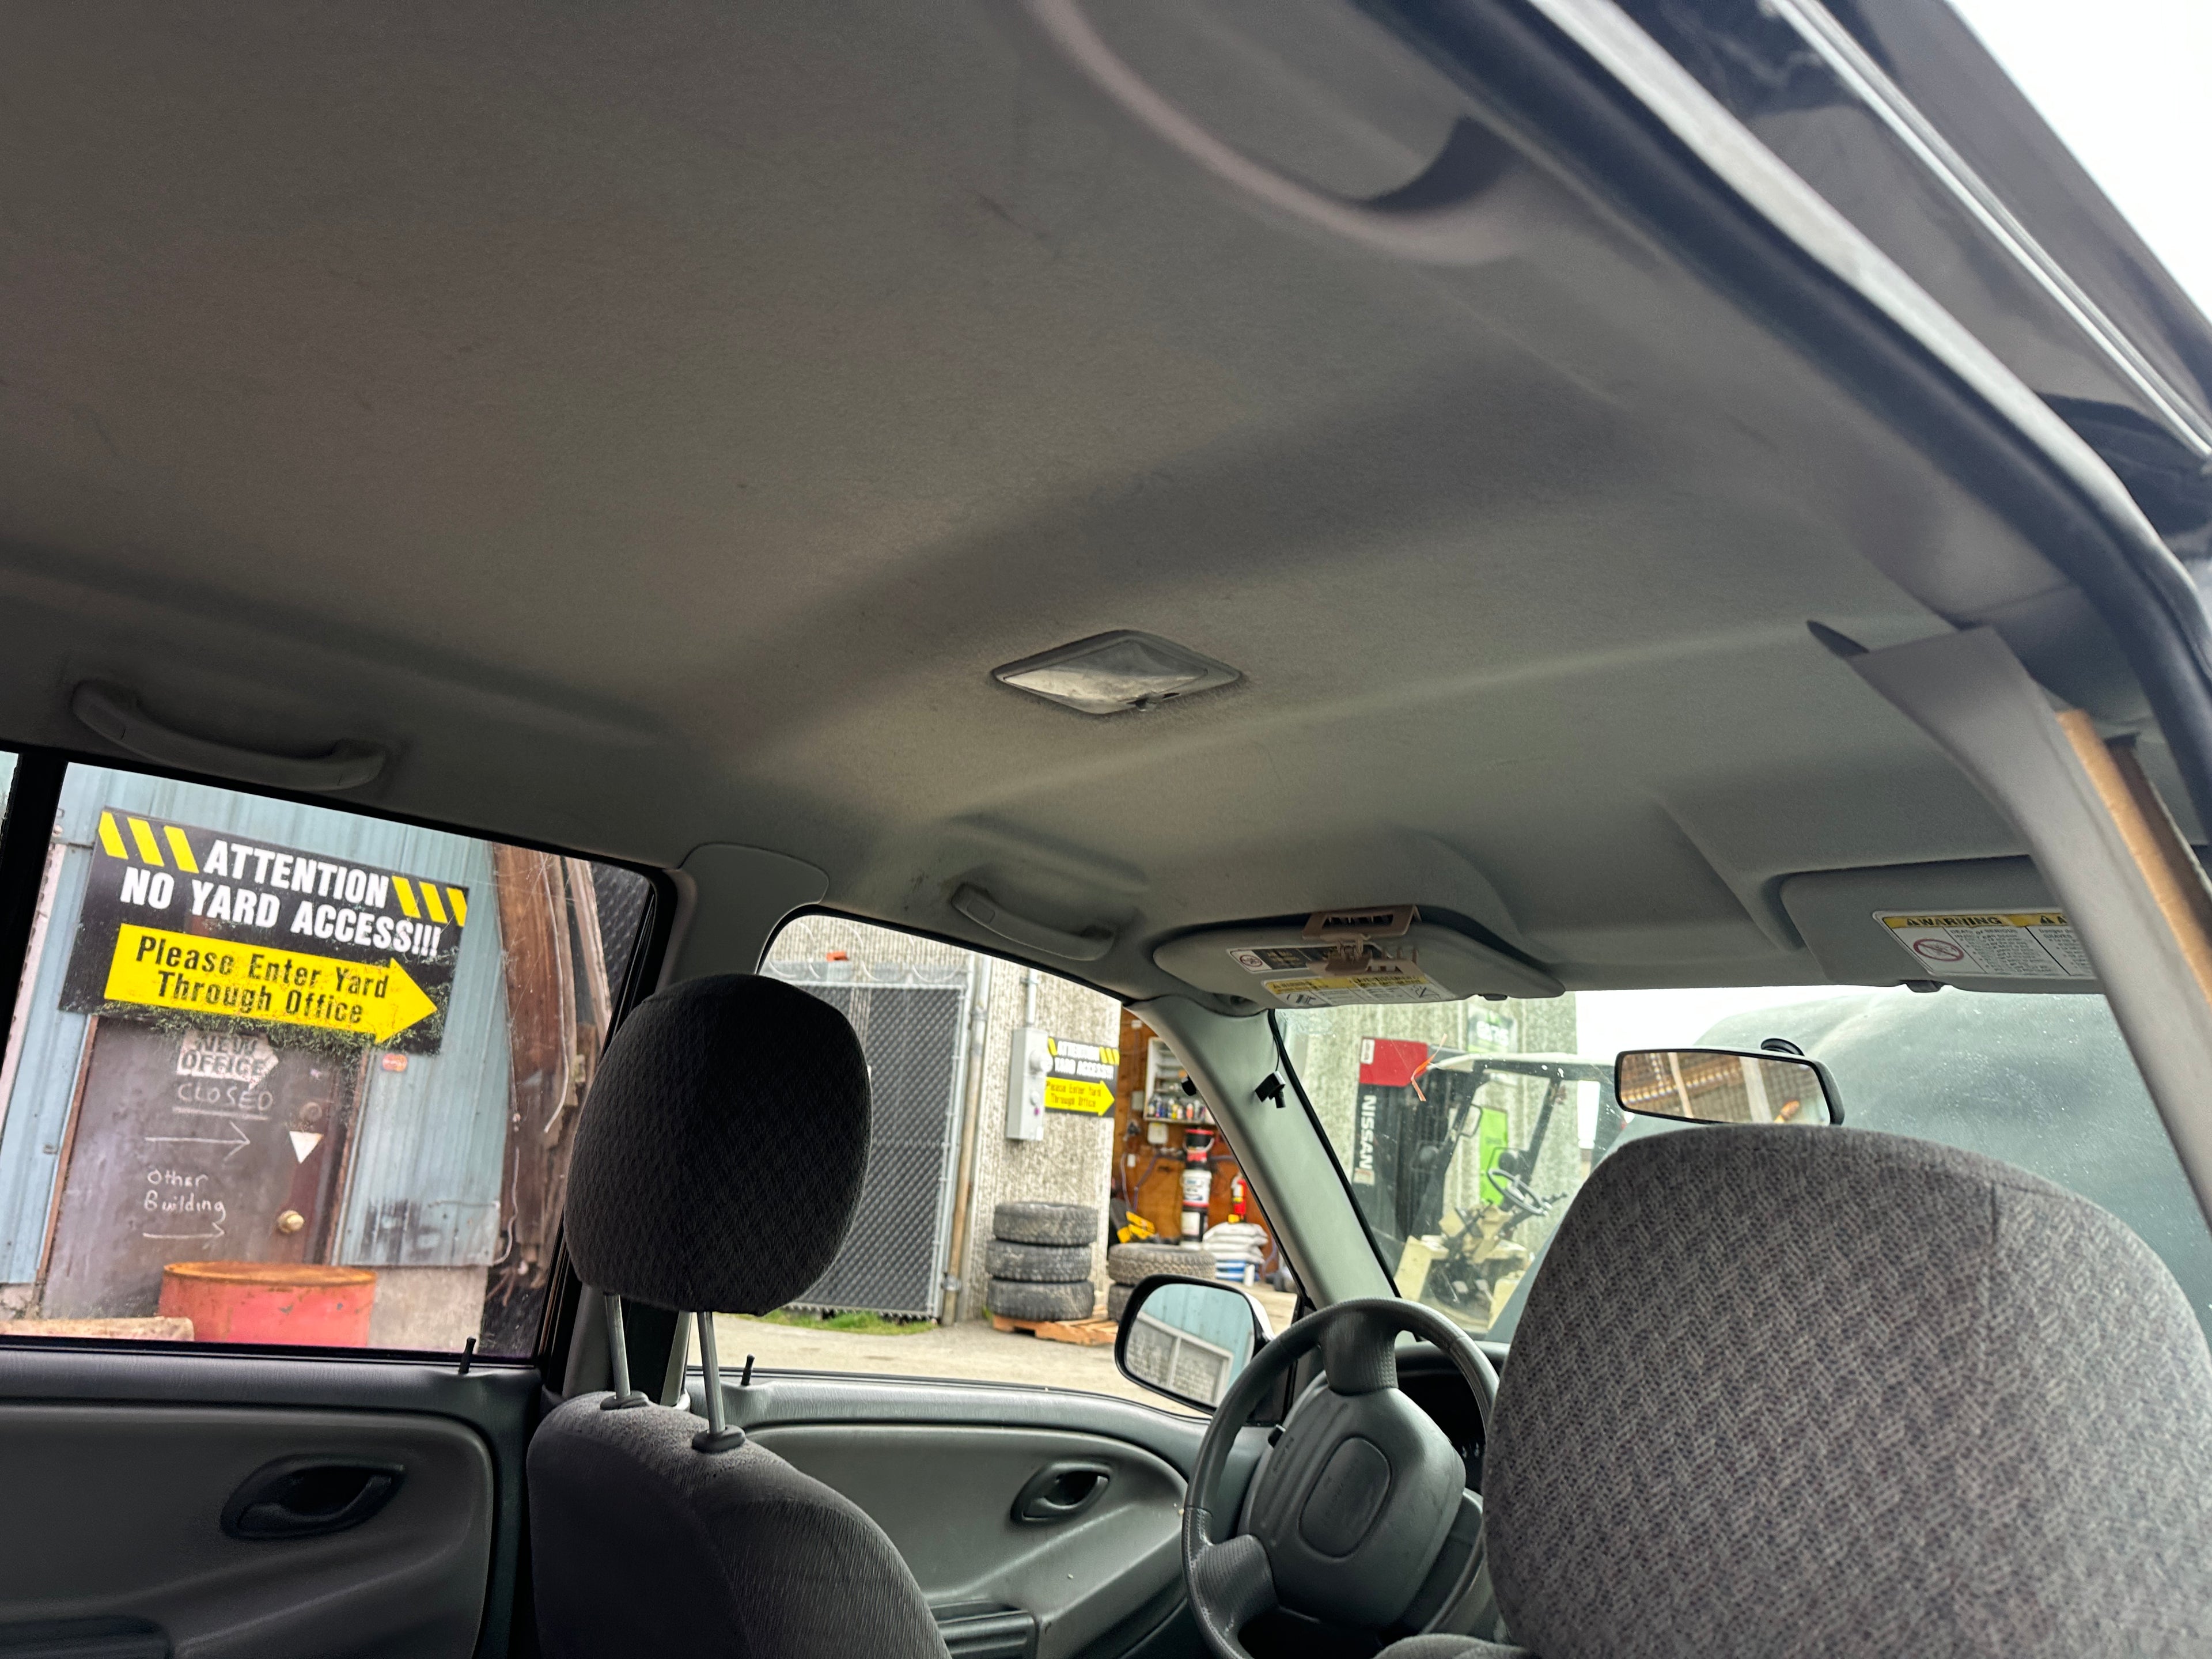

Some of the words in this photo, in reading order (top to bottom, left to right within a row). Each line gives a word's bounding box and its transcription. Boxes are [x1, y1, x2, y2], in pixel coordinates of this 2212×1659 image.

[203, 839, 389, 908] ATTENTION
[120, 866, 175, 910] NO
[191, 878, 280, 929] YARD
[290, 900, 442, 957] ACCESS!!!
[136, 935, 234, 976] Please
[248, 954, 321, 988] Enter
[336, 967, 389, 999] Yard
[158, 970, 272, 1014] Through
[285, 989, 363, 1024] Office
[1057, 1040, 1100, 1061] ATTENTION
[177, 1081, 273, 1111] CLOSED
[1359, 1095, 1377, 1169] NISSAN
[147, 1168, 209, 1187] Other
[144, 1190, 226, 1224] Building
